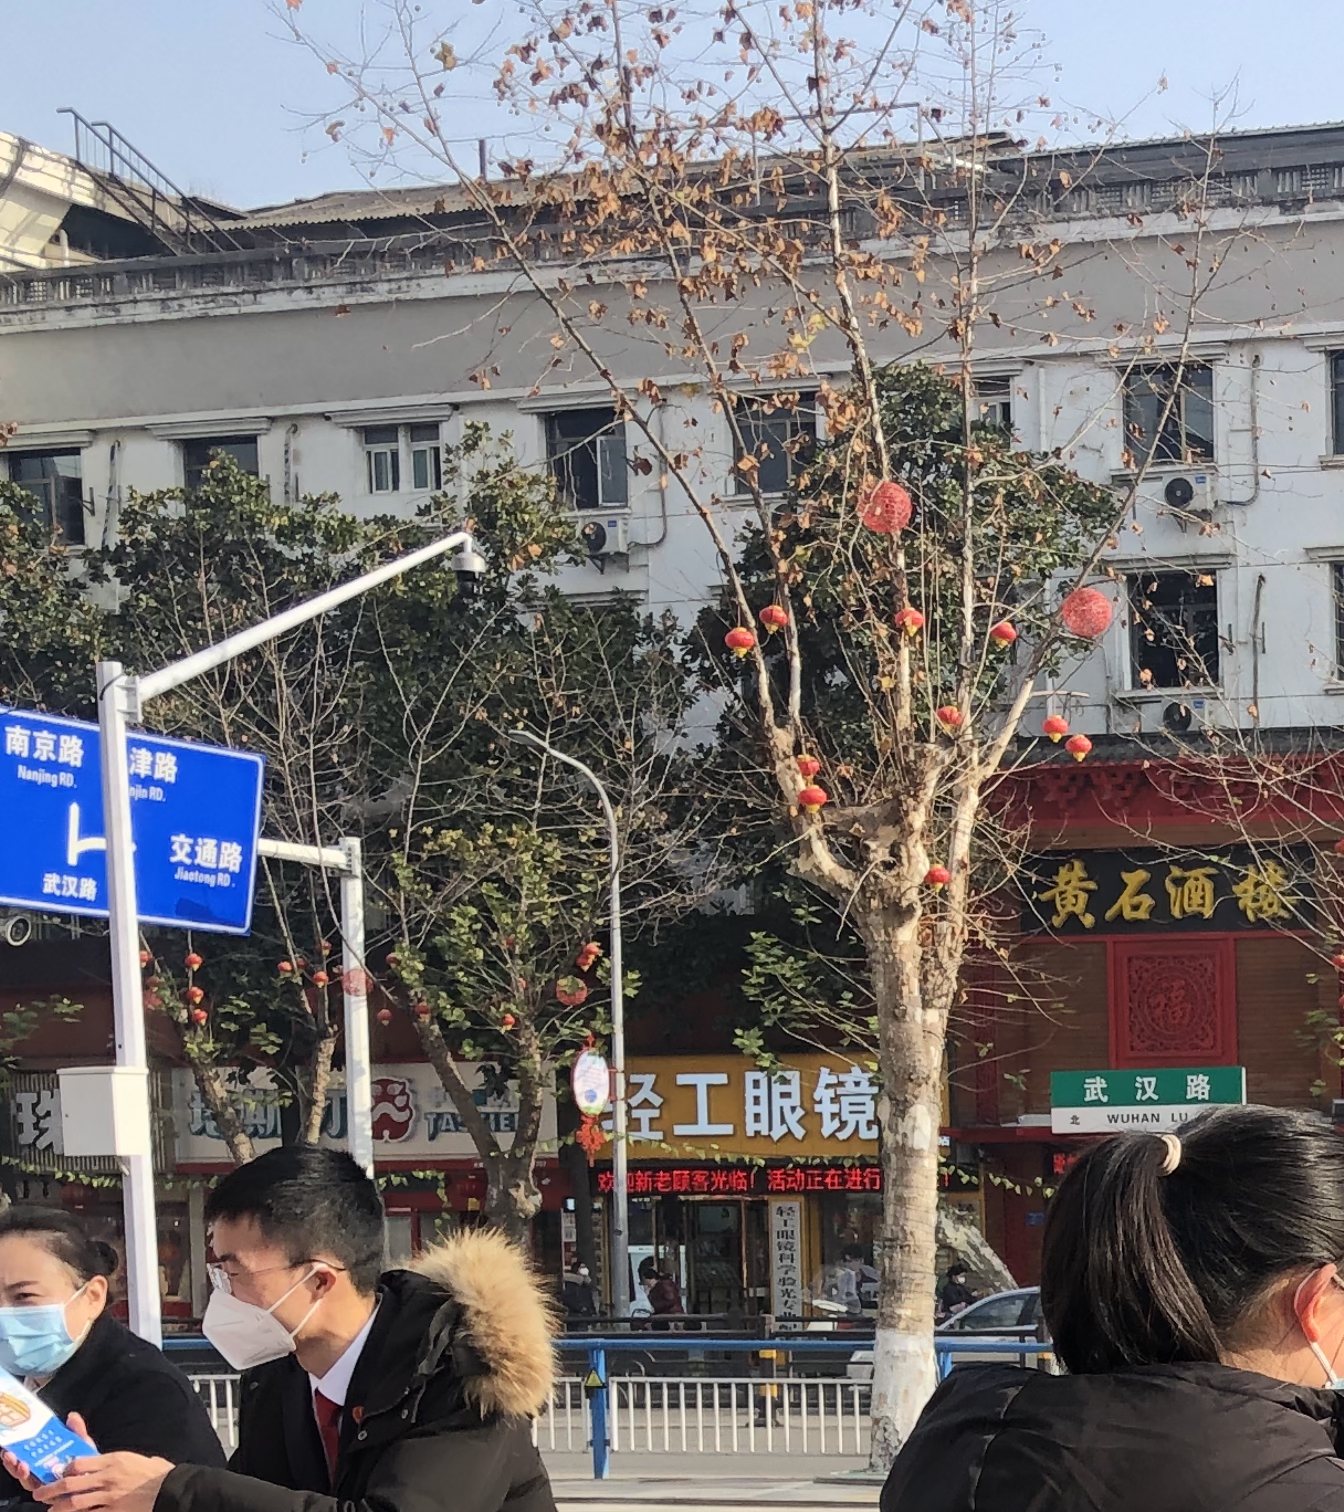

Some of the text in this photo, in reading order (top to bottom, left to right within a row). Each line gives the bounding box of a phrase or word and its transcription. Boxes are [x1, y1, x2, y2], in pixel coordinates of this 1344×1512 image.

[5, 725, 84, 768] 南京路
[17, 764, 58, 788] Nanjing
[129, 746, 178, 784] 津路
[170, 834, 243, 873] 交通路
[42, 872, 97, 901] 武汉路
[175, 866, 216, 887] Jiaotong
[1083, 1073, 1212, 1103] 武汉路
[600, 1066, 880, 1143] 轻工眼镜
[1107, 1112, 1188, 1124] WUHAN LU
[1070, 1114, 1081, 1126] 北
